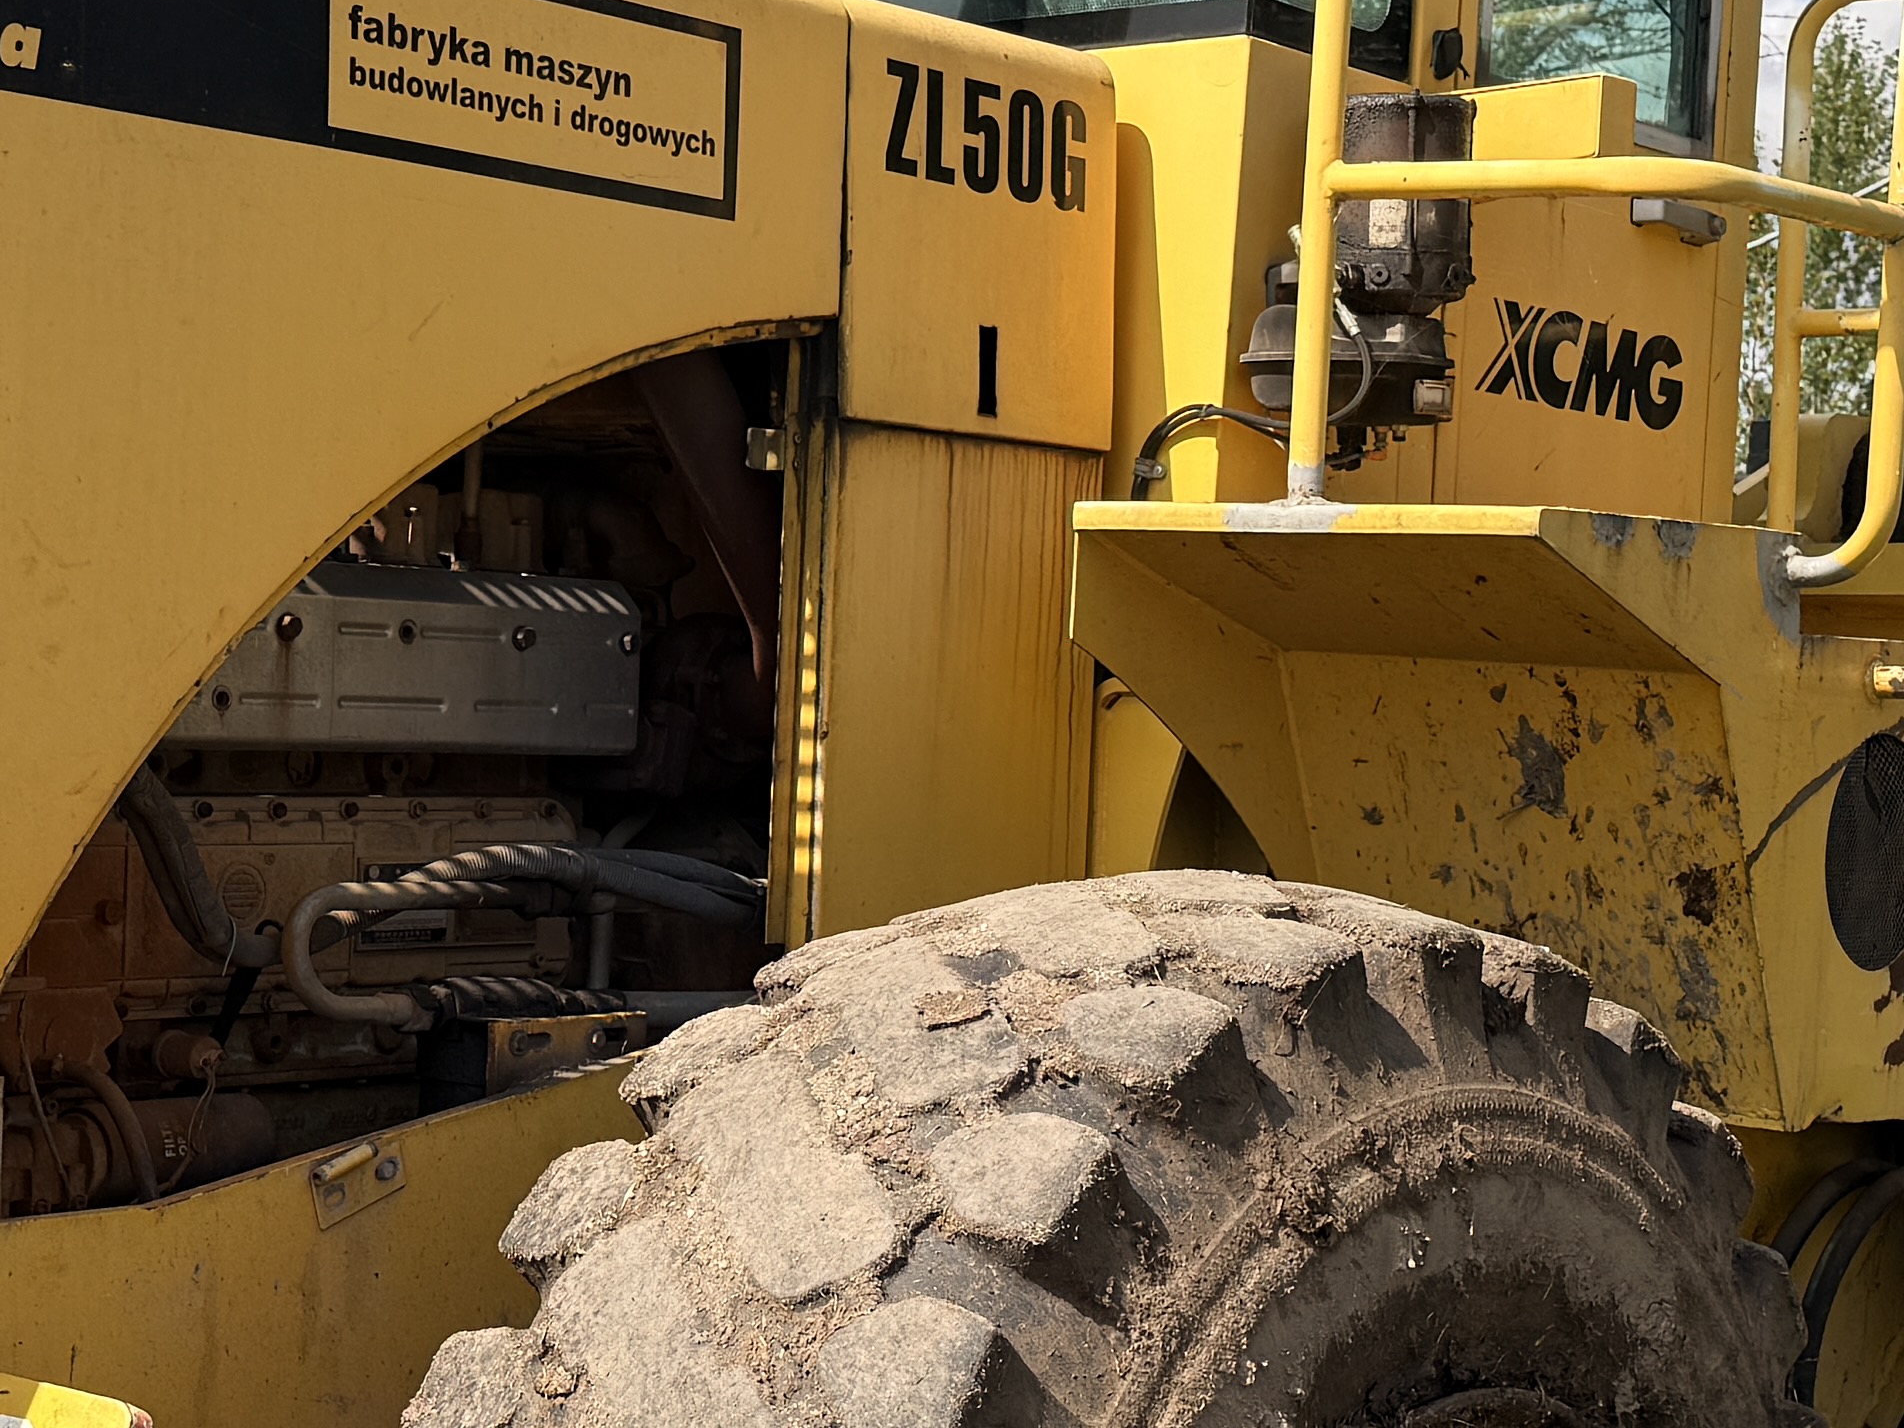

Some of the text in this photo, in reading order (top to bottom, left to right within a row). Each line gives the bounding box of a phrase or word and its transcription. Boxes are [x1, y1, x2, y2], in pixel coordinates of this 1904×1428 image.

[347, 4, 632, 101] fabryka maszyn
[348, 57, 716, 157] budowlanych i drogowych
[884, 58, 1088, 214] ZL50G
[1475, 297, 1684, 430] XCMG
